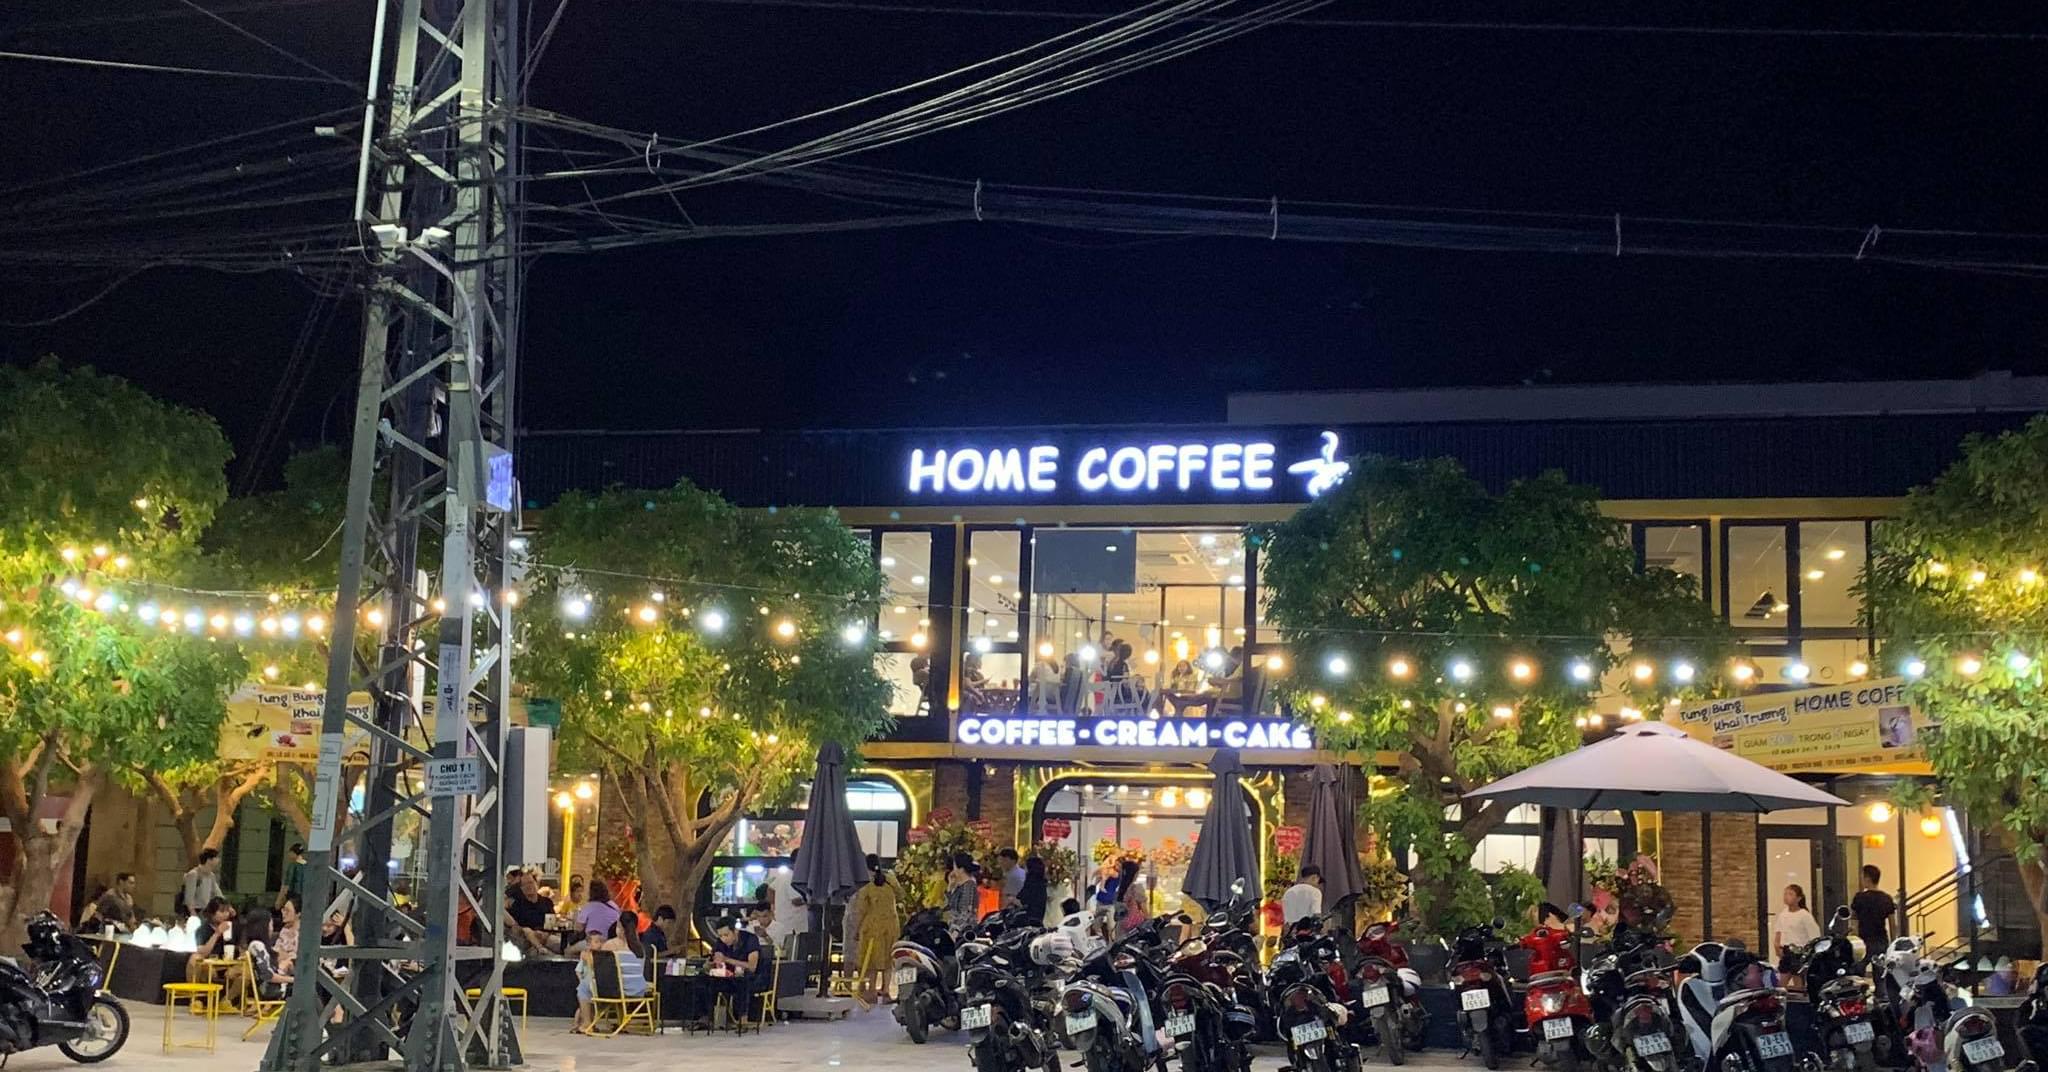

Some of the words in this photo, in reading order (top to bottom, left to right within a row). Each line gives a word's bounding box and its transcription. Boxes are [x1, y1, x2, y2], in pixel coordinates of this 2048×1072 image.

[909, 446, 1059, 492] HOME
[1078, 443, 1275, 491] COFFEE
[1794, 690, 1852, 712] HOME
[1857, 684, 1906, 704] COFF
[293, 708, 320, 718] Khai
[958, 718, 1076, 746] COFFEE
[1095, 719, 1208, 747] CREAM
[1223, 721, 1312, 748] CAKE
[1714, 718, 1740, 732] Khai
[1798, 731, 1832, 743] TRONG
